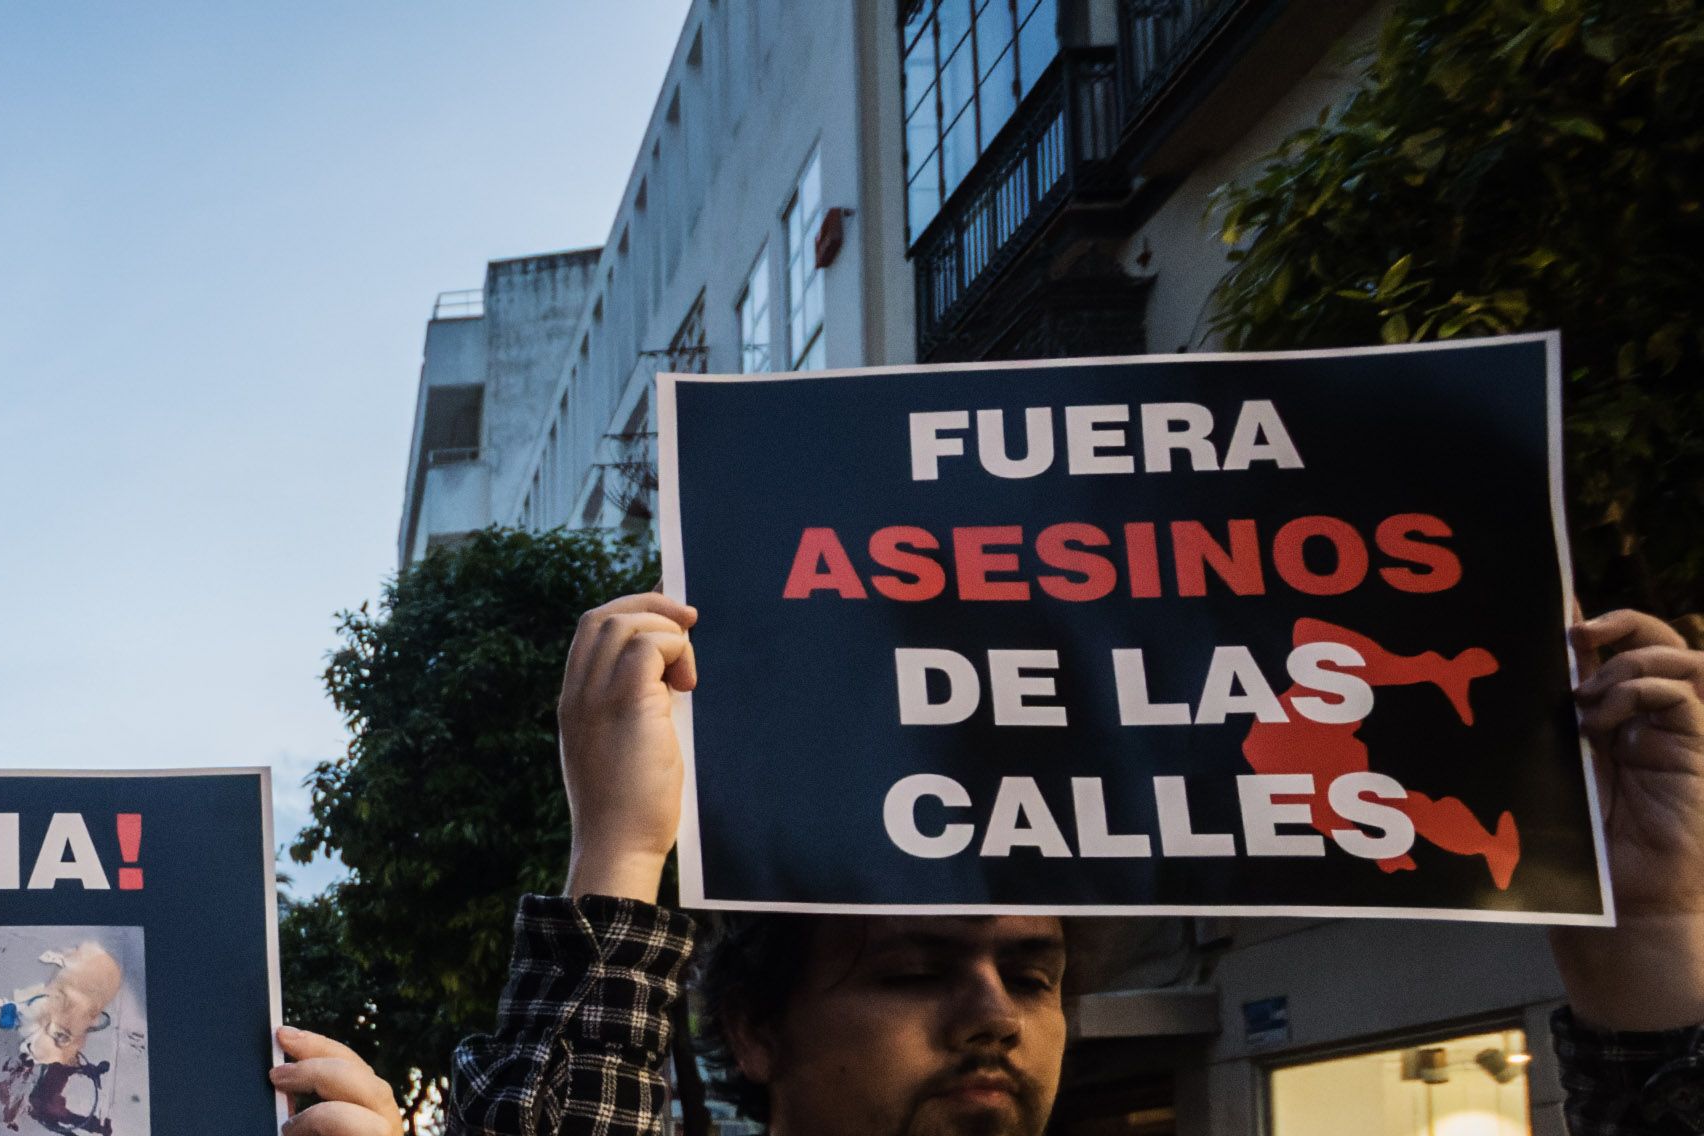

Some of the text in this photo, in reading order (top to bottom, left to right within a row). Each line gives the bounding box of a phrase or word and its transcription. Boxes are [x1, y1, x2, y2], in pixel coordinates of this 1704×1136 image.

[909, 400, 1304, 481] FUERA
[783, 513, 1463, 602] ASESINOS
[895, 642, 1375, 726] DE LAS
[883, 773, 1416, 859] CALLES
